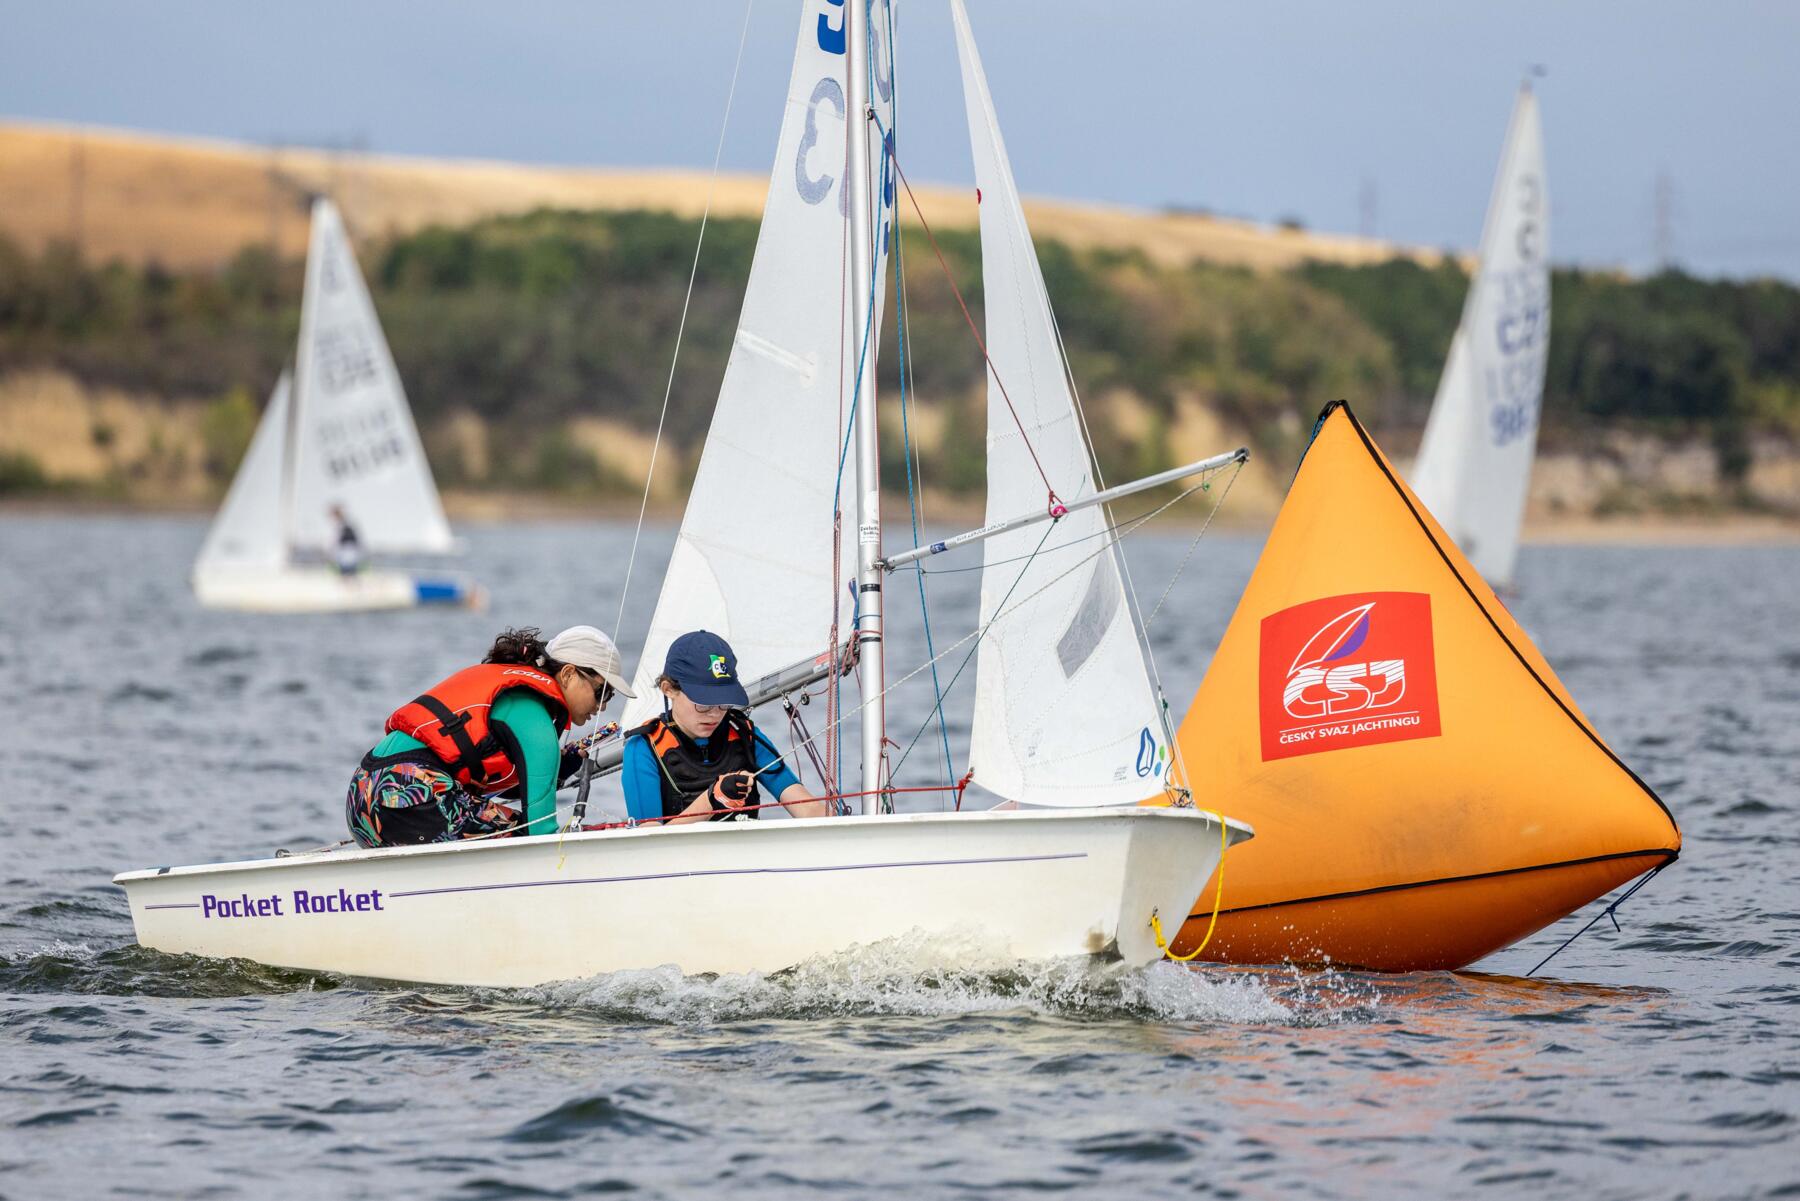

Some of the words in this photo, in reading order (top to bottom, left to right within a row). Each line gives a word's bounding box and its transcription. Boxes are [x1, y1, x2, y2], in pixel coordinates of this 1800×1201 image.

[1279, 728, 1316, 744] ČESKÝ
[1319, 725, 1350, 738] SVAZ
[1352, 716, 1420, 735] JACHTINGU
[202, 893, 284, 918] Pocket
[293, 888, 384, 914] Rocket
